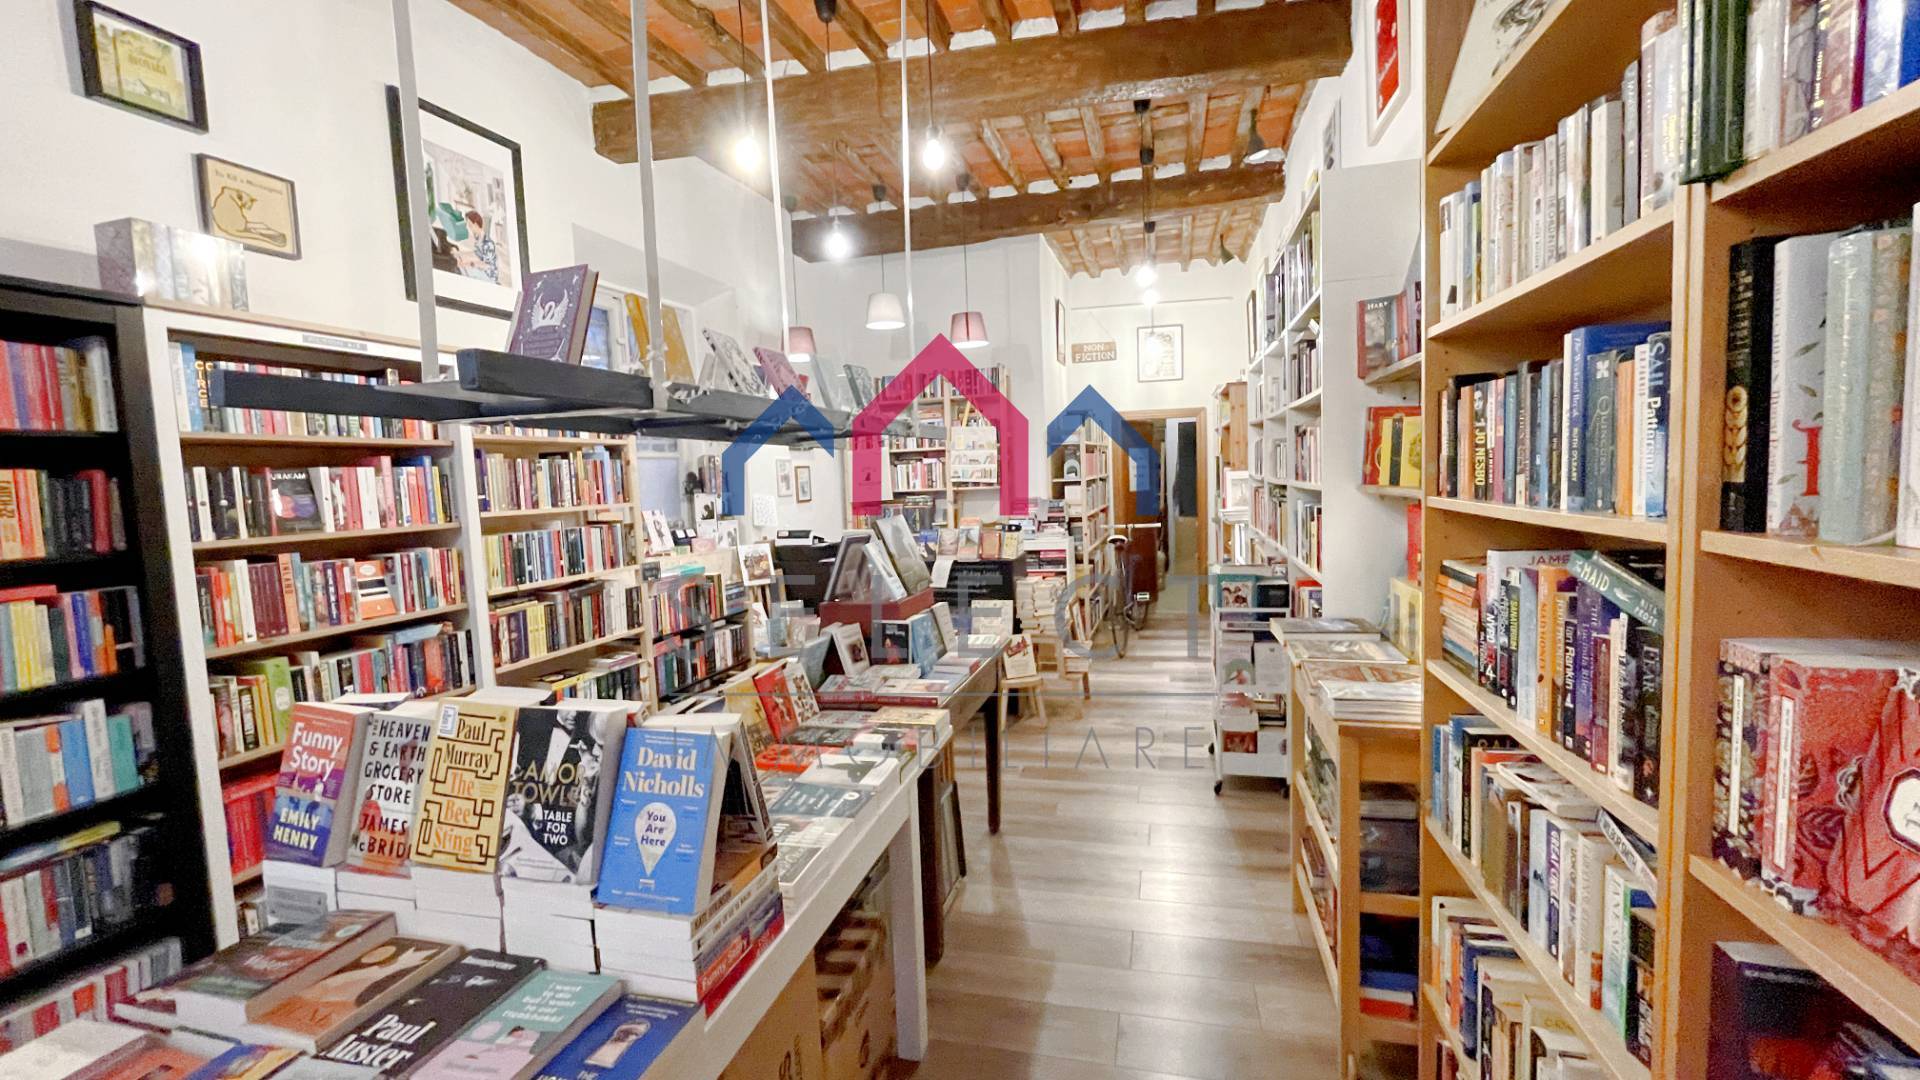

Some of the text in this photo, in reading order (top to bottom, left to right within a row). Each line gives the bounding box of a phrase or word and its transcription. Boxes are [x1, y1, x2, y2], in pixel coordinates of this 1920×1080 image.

[1075, 351, 1115, 362] FICTION
[1083, 343, 1105, 352] NON
[1648, 342, 1666, 386] SAIL
[194, 360, 209, 408] CIRCE
[1646, 396, 1662, 473] Patterson
[1527, 554, 1571, 566] JAME
[1581, 562, 1610, 592] MAID
[1485, 612, 1497, 643] NYPD
[1509, 600, 1519, 650] SANATORIUM
[1565, 645, 1575, 690] Rankin
[1642, 645, 1660, 692] FEAR
[292, 722, 344, 758] Funny
[378, 719, 431, 743] HEAVEN
[456, 718, 487, 742] Paul
[290, 745, 337, 781] Story
[369, 741, 427, 762] & EARTH
[443, 743, 493, 773] Murray
[636, 746, 697, 771] David
[364, 762, 424, 785] GROCERY
[449, 769, 475, 795] The
[523, 759, 586, 786] AMOR
[622, 770, 705, 798] Nicholls
[366, 784, 412, 805] STORE
[513, 782, 594, 808] TOWLES
[279, 807, 321, 831] EMILY
[360, 813, 408, 836] JAMES
[444, 799, 471, 825] Bee
[543, 809, 573, 822] TABLE
[646, 810, 666, 823] You
[273, 825, 319, 851] HENRY
[433, 826, 473, 857] Sting
[543, 834, 568, 845] TWO
[546, 823, 567, 834] FOR
[640, 835, 666, 847] Here
[644, 823, 665, 834] Are
[1550, 830, 1560, 865] GREAT
[361, 1013, 438, 1045] Paul
